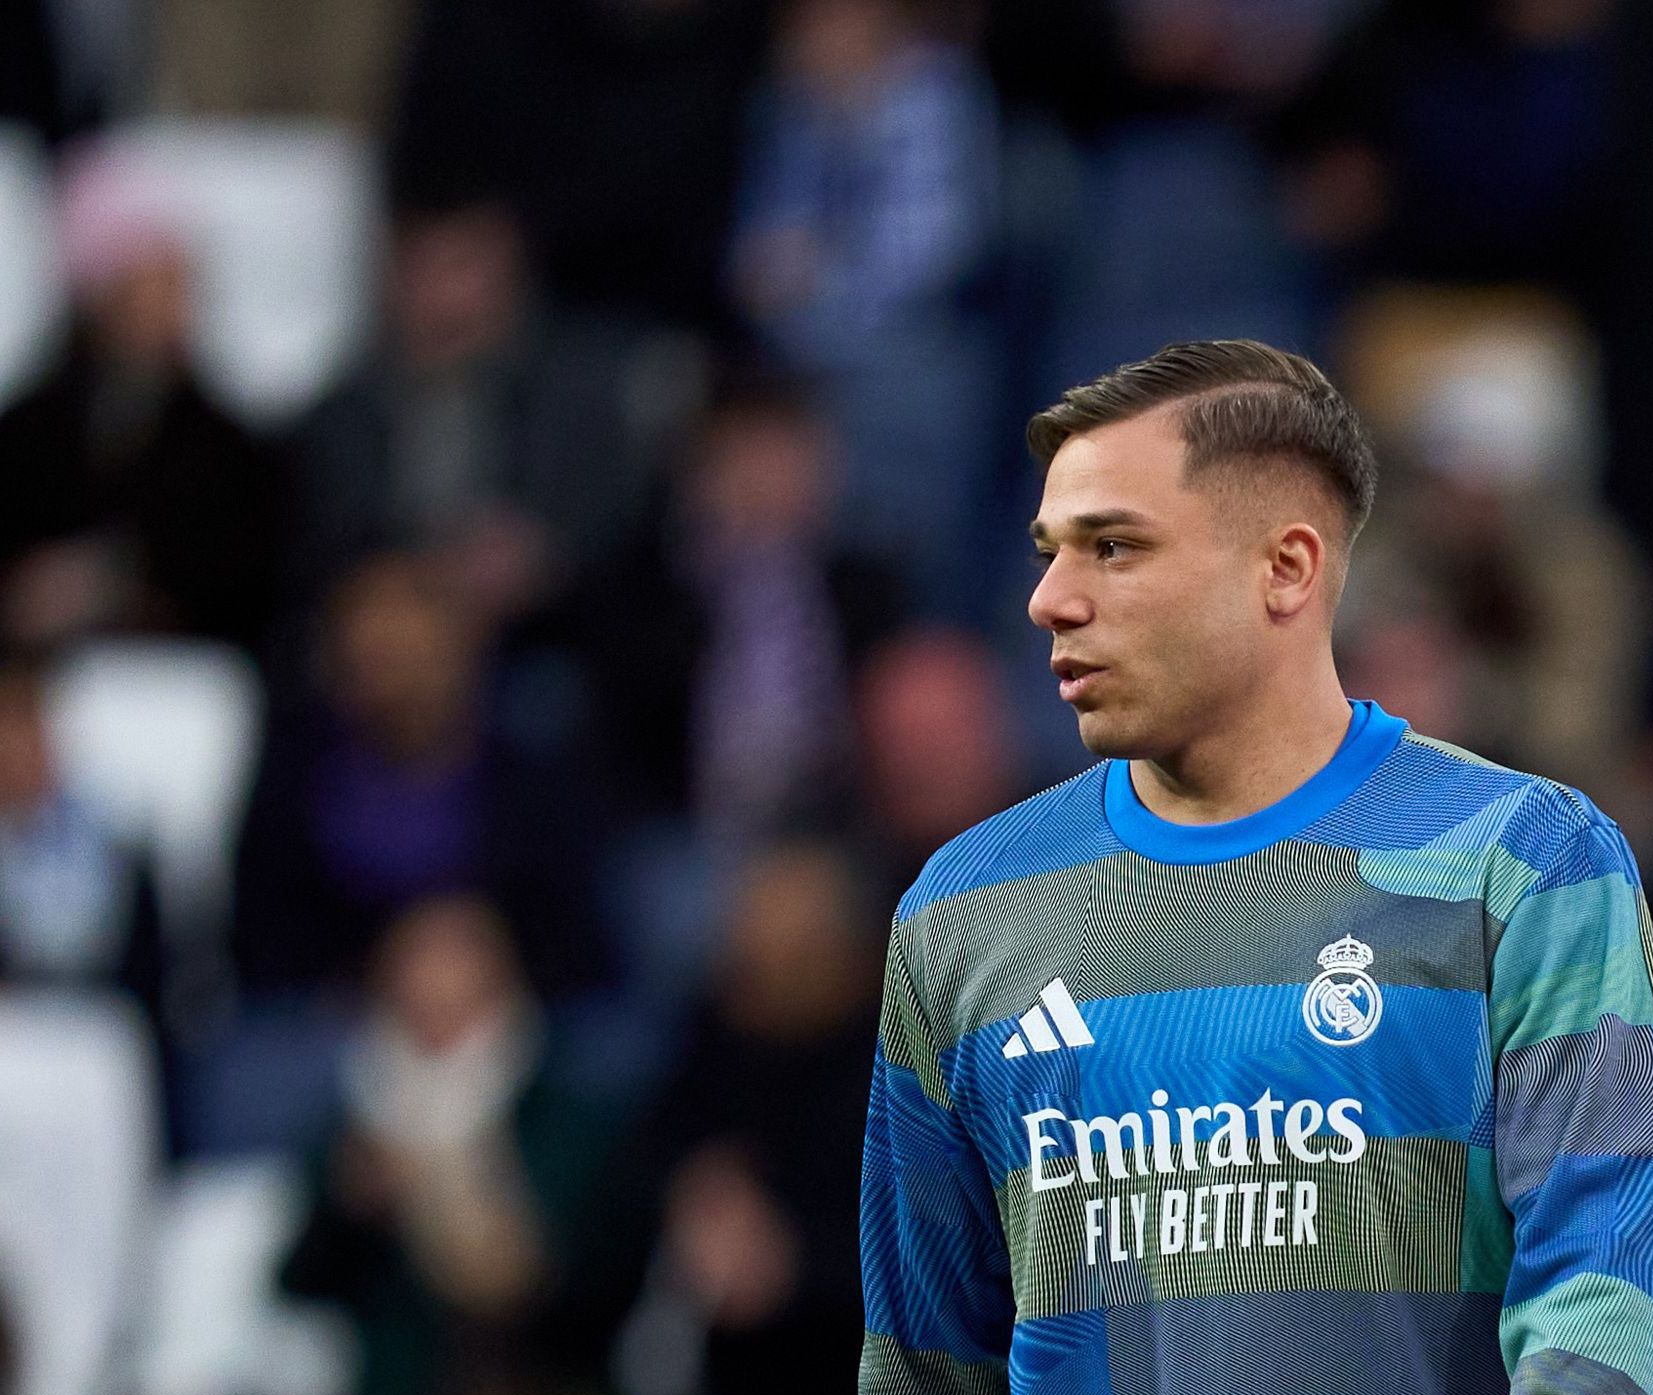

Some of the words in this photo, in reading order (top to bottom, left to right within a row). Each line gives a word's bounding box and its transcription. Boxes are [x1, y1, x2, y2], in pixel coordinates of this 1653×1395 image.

[1021, 1086, 1367, 1193] Emirates
[1085, 1192, 1148, 1266] FLY
[1160, 1180, 1319, 1256] BETTER
